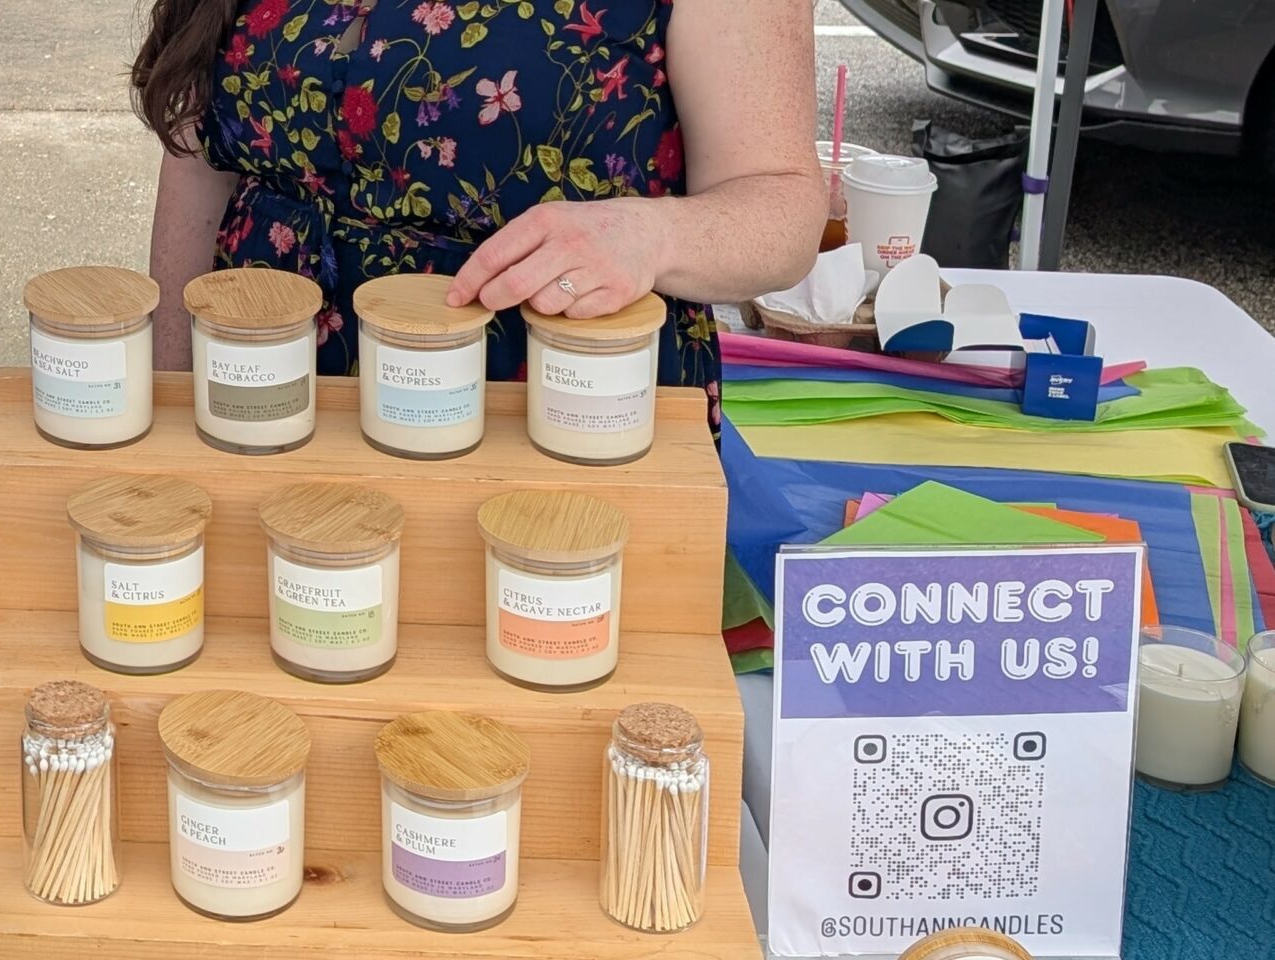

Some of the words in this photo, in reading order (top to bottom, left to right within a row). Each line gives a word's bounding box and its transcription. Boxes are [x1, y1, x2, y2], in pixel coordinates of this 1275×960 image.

[33, 347, 89, 370] BEACHWOOD
[211, 359, 230, 372] BAY
[234, 364, 261, 374] LEAF
[38, 360, 53, 372] SEA
[55, 366, 81, 378] SALT
[212, 370, 219, 378] &
[222, 372, 276, 382] TOBACCO
[382, 362, 402, 375] DRY
[405, 367, 427, 377] GIN
[545, 362, 576, 378] BIRCH
[382, 372, 390, 381] &
[392, 374, 442, 386] CYPRESS
[545, 372, 553, 383] &
[554, 375, 594, 390] SMOKE
[111, 580, 140, 592] SALT
[111, 589, 120, 599] &
[122, 590, 165, 601] CITRUS
[277, 576, 342, 598] GRAPEFRUIT
[285, 589, 319, 606] GREEN
[323, 597, 347, 608] TEA
[503, 588, 543, 606] CITRUS
[801, 578, 1115, 628] CONNECT
[503, 597, 511, 608] &
[513, 601, 553, 616] AGAVE
[557, 602, 602, 617] NECTAR
[809, 639, 975, 684] WITH
[999, 636, 1100, 681] US!
[180, 814, 220, 836] GINGER
[181, 824, 189, 834] &
[189, 829, 227, 846] PEACH
[396, 823, 457, 848] CASHMERE
[396, 832, 404, 843] &
[405, 837, 436, 855] PLUM
